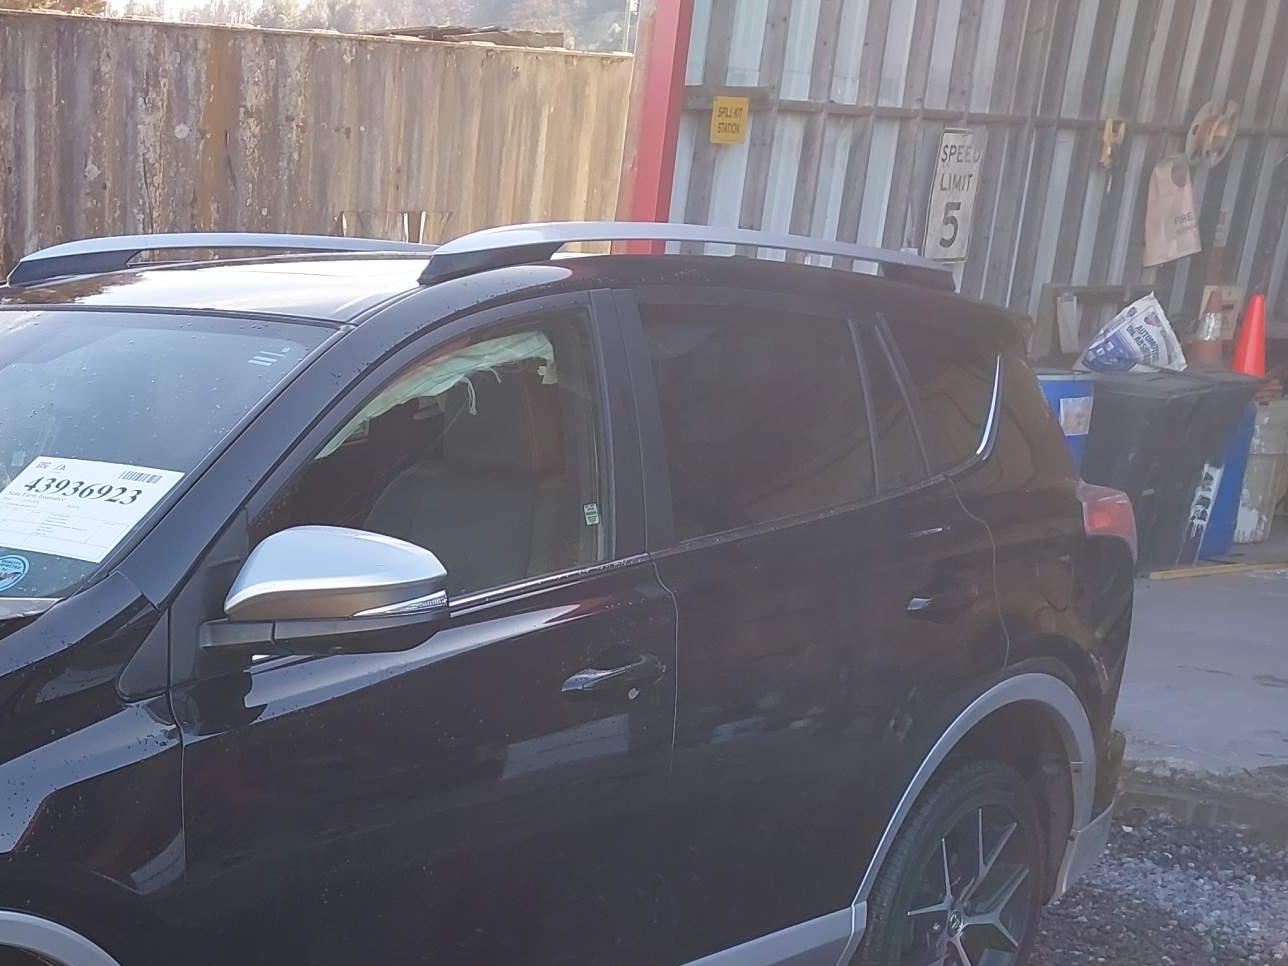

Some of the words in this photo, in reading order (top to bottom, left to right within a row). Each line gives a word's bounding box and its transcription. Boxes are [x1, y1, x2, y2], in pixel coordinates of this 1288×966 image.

[941, 144, 981, 163] SPEED
[940, 173, 974, 191] LIMIT
[939, 201, 962, 248] 5
[24, 476, 143, 505] 43936923
